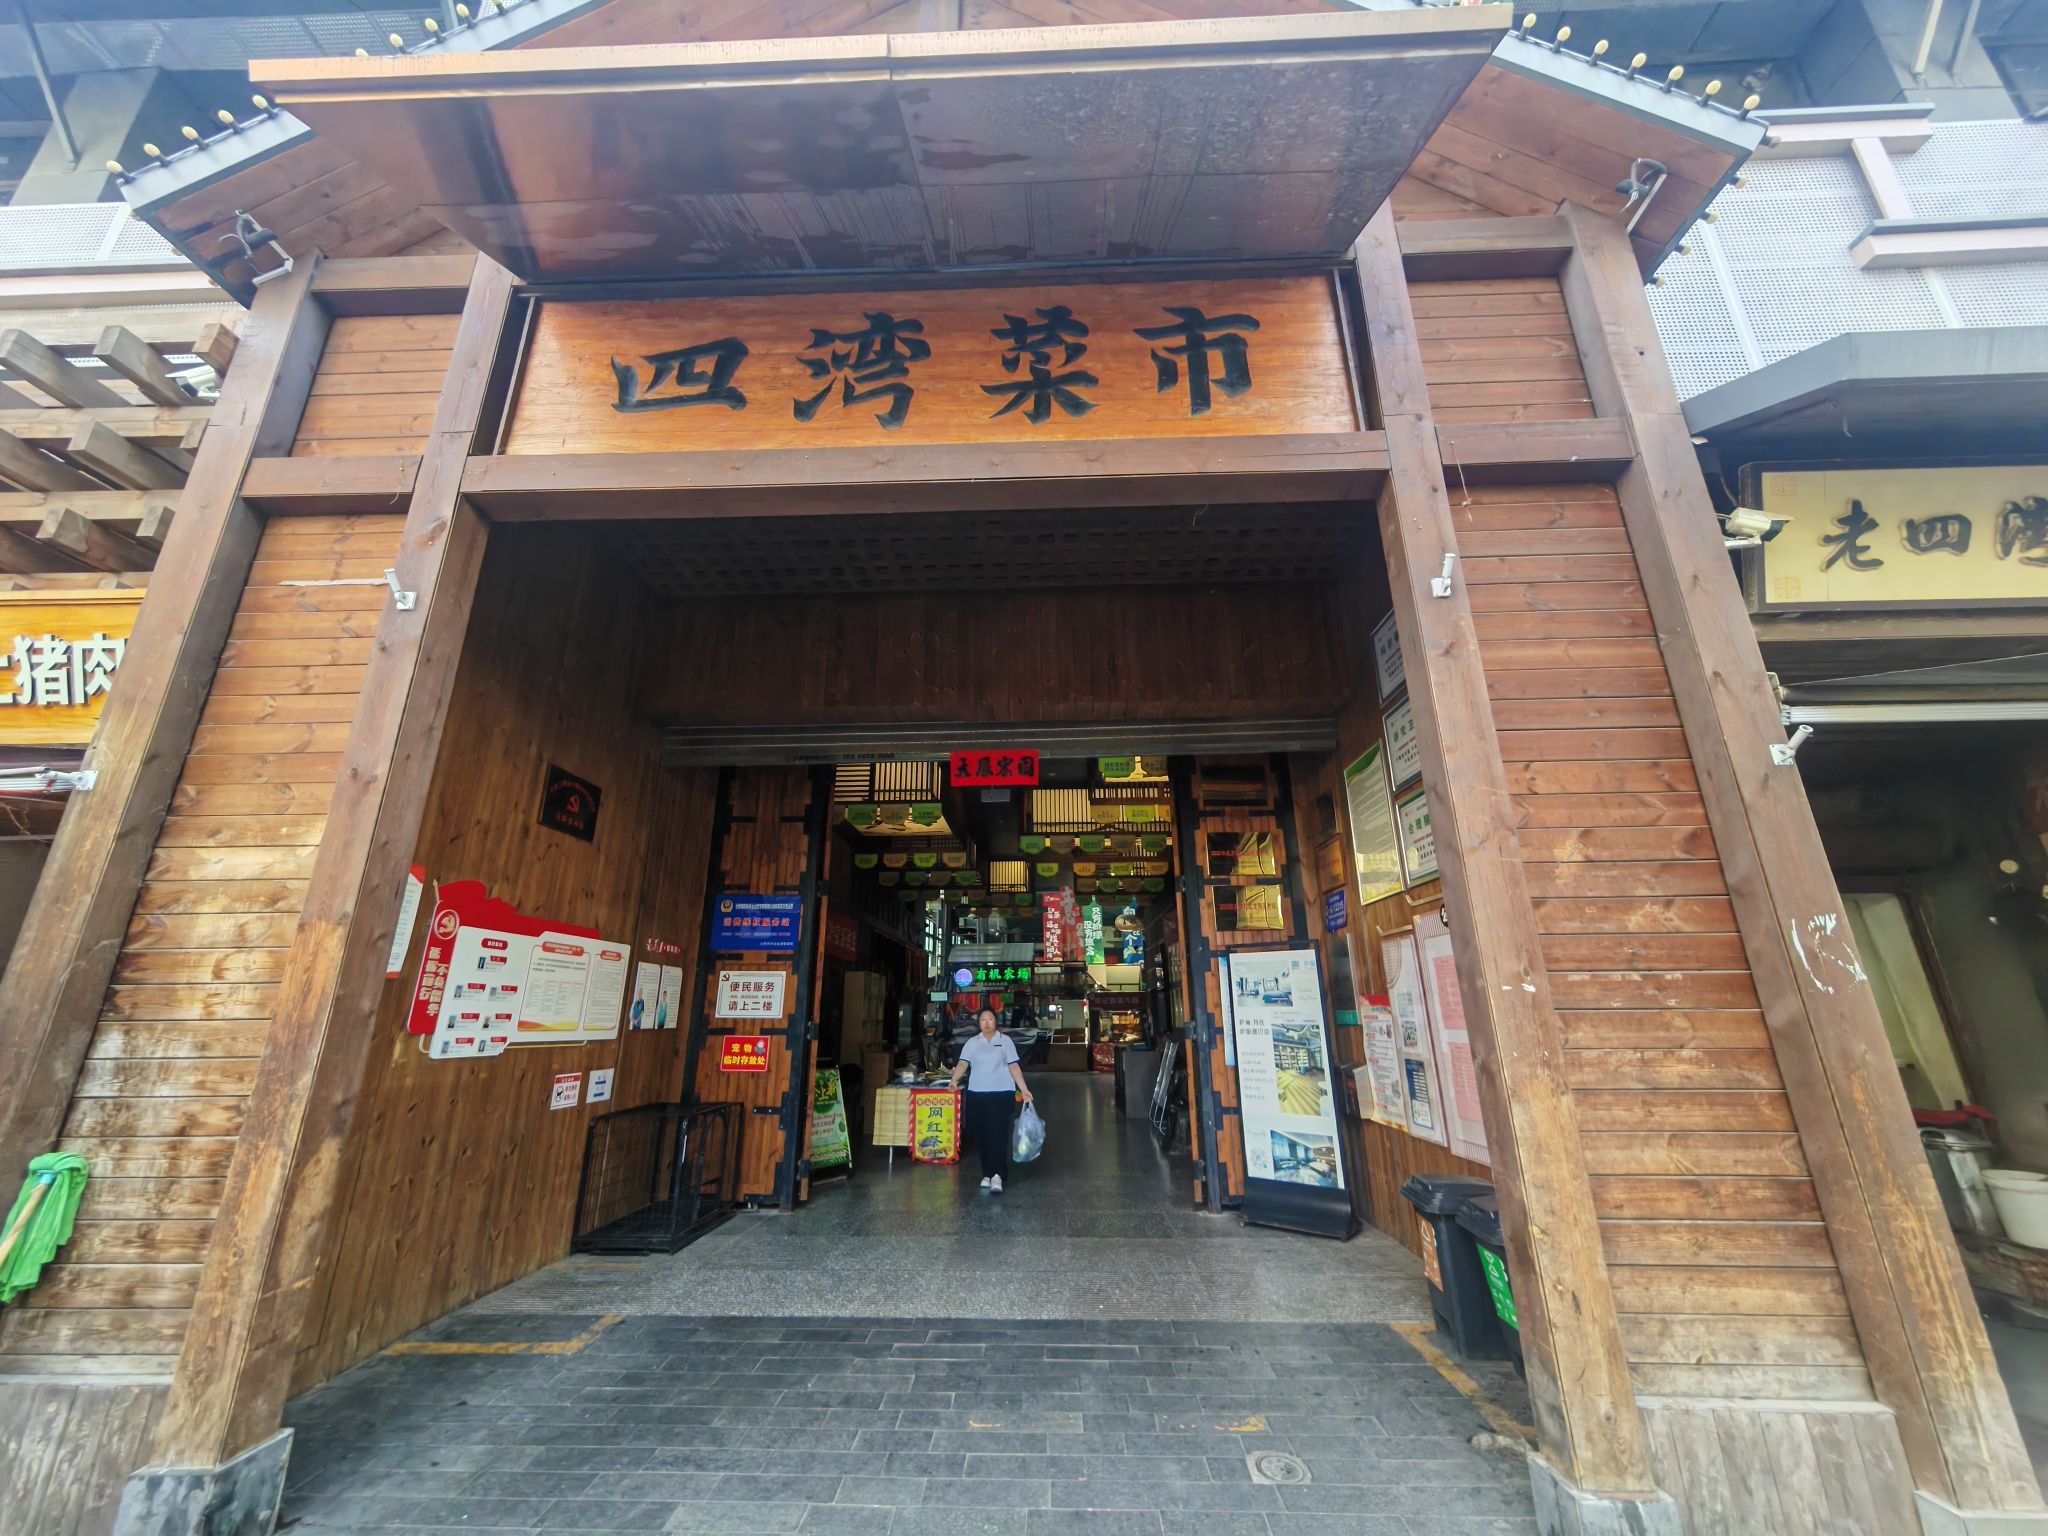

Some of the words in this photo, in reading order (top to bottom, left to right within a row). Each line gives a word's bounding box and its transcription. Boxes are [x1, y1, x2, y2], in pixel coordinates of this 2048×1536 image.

[610, 306, 1260, 430] 四湾菜市
[976, 966, 1029, 981] 有机农场
[729, 981, 775, 992] 便民服务
[728, 1000, 773, 1011] 请上二楼
[723, 1055, 765, 1065] 临时存放处
